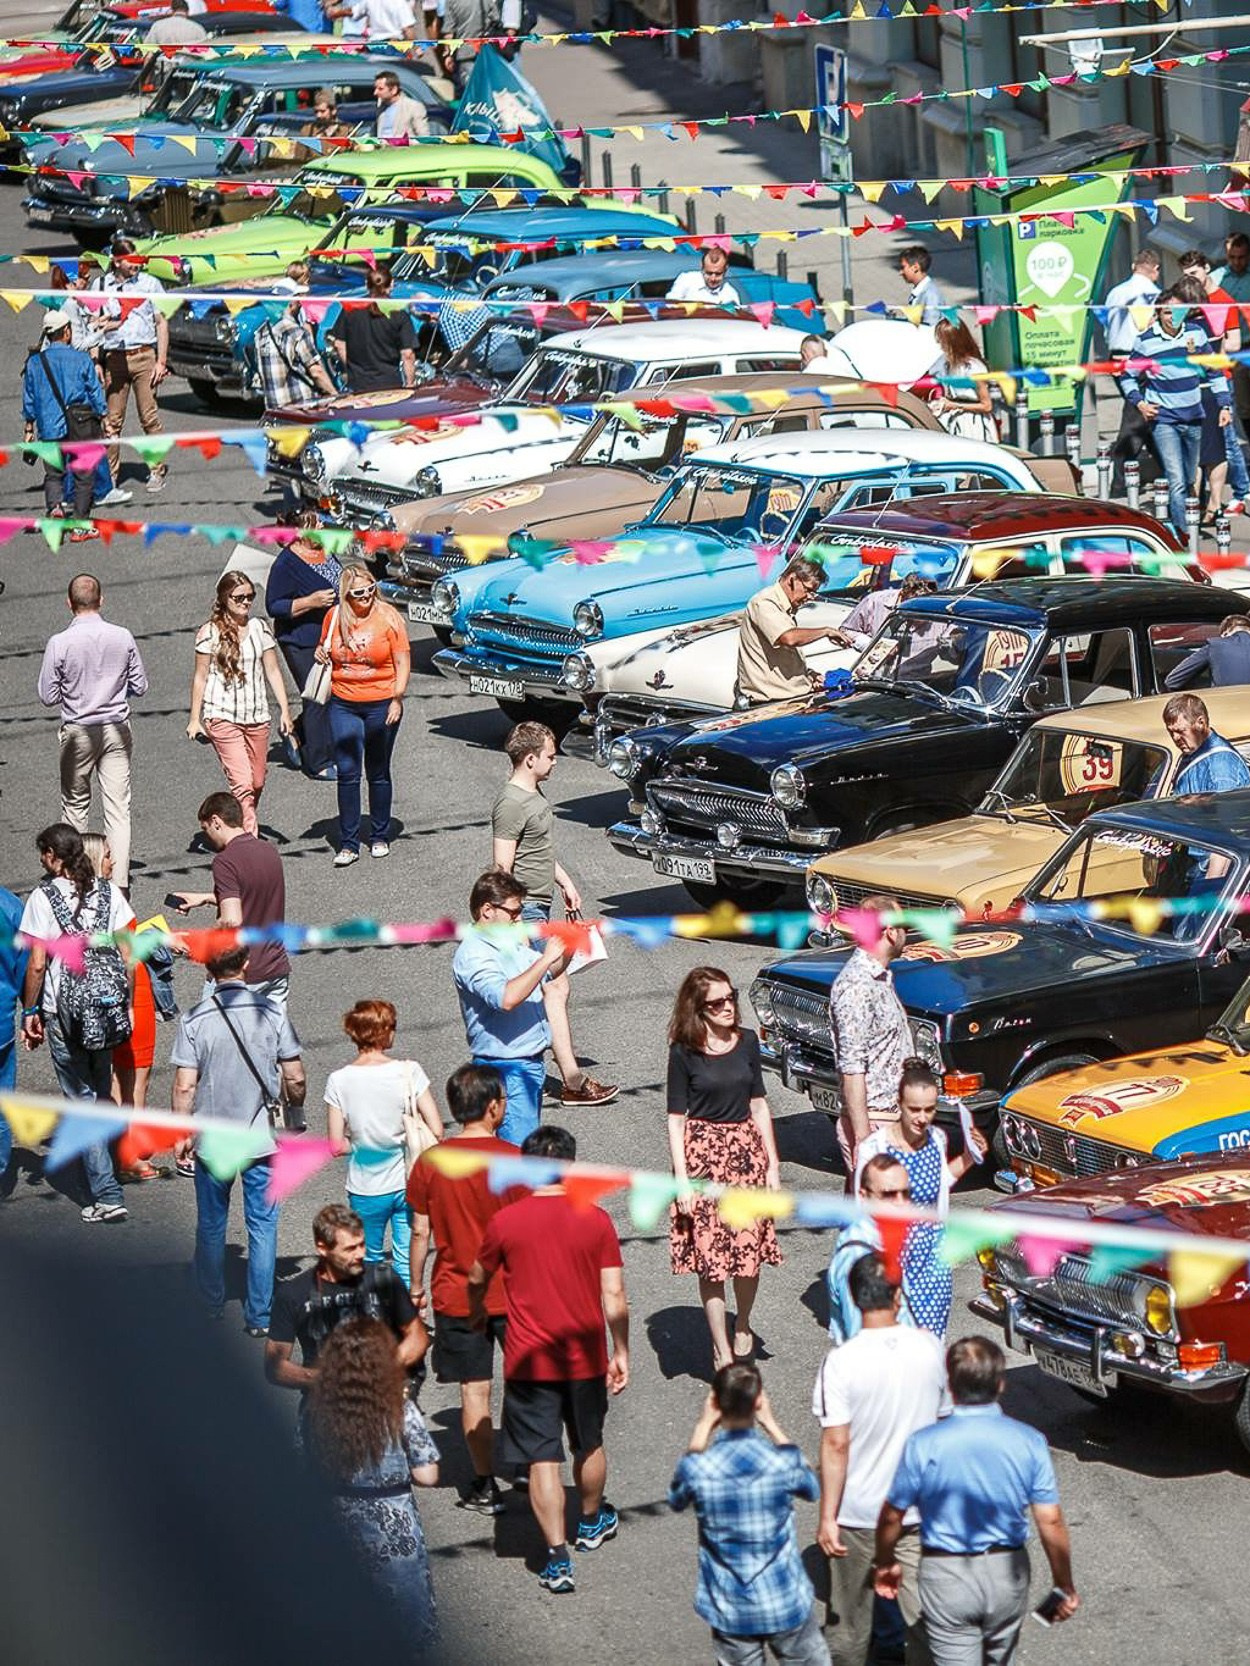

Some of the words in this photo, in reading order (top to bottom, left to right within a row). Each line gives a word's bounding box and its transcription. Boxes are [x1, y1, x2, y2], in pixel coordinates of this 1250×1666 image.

[1032, 257, 1055, 270] 100
[1025, 331, 1060, 340] Оплата
[1025, 339, 1075, 349] почасовая
[1083, 755, 1113, 780] 39
